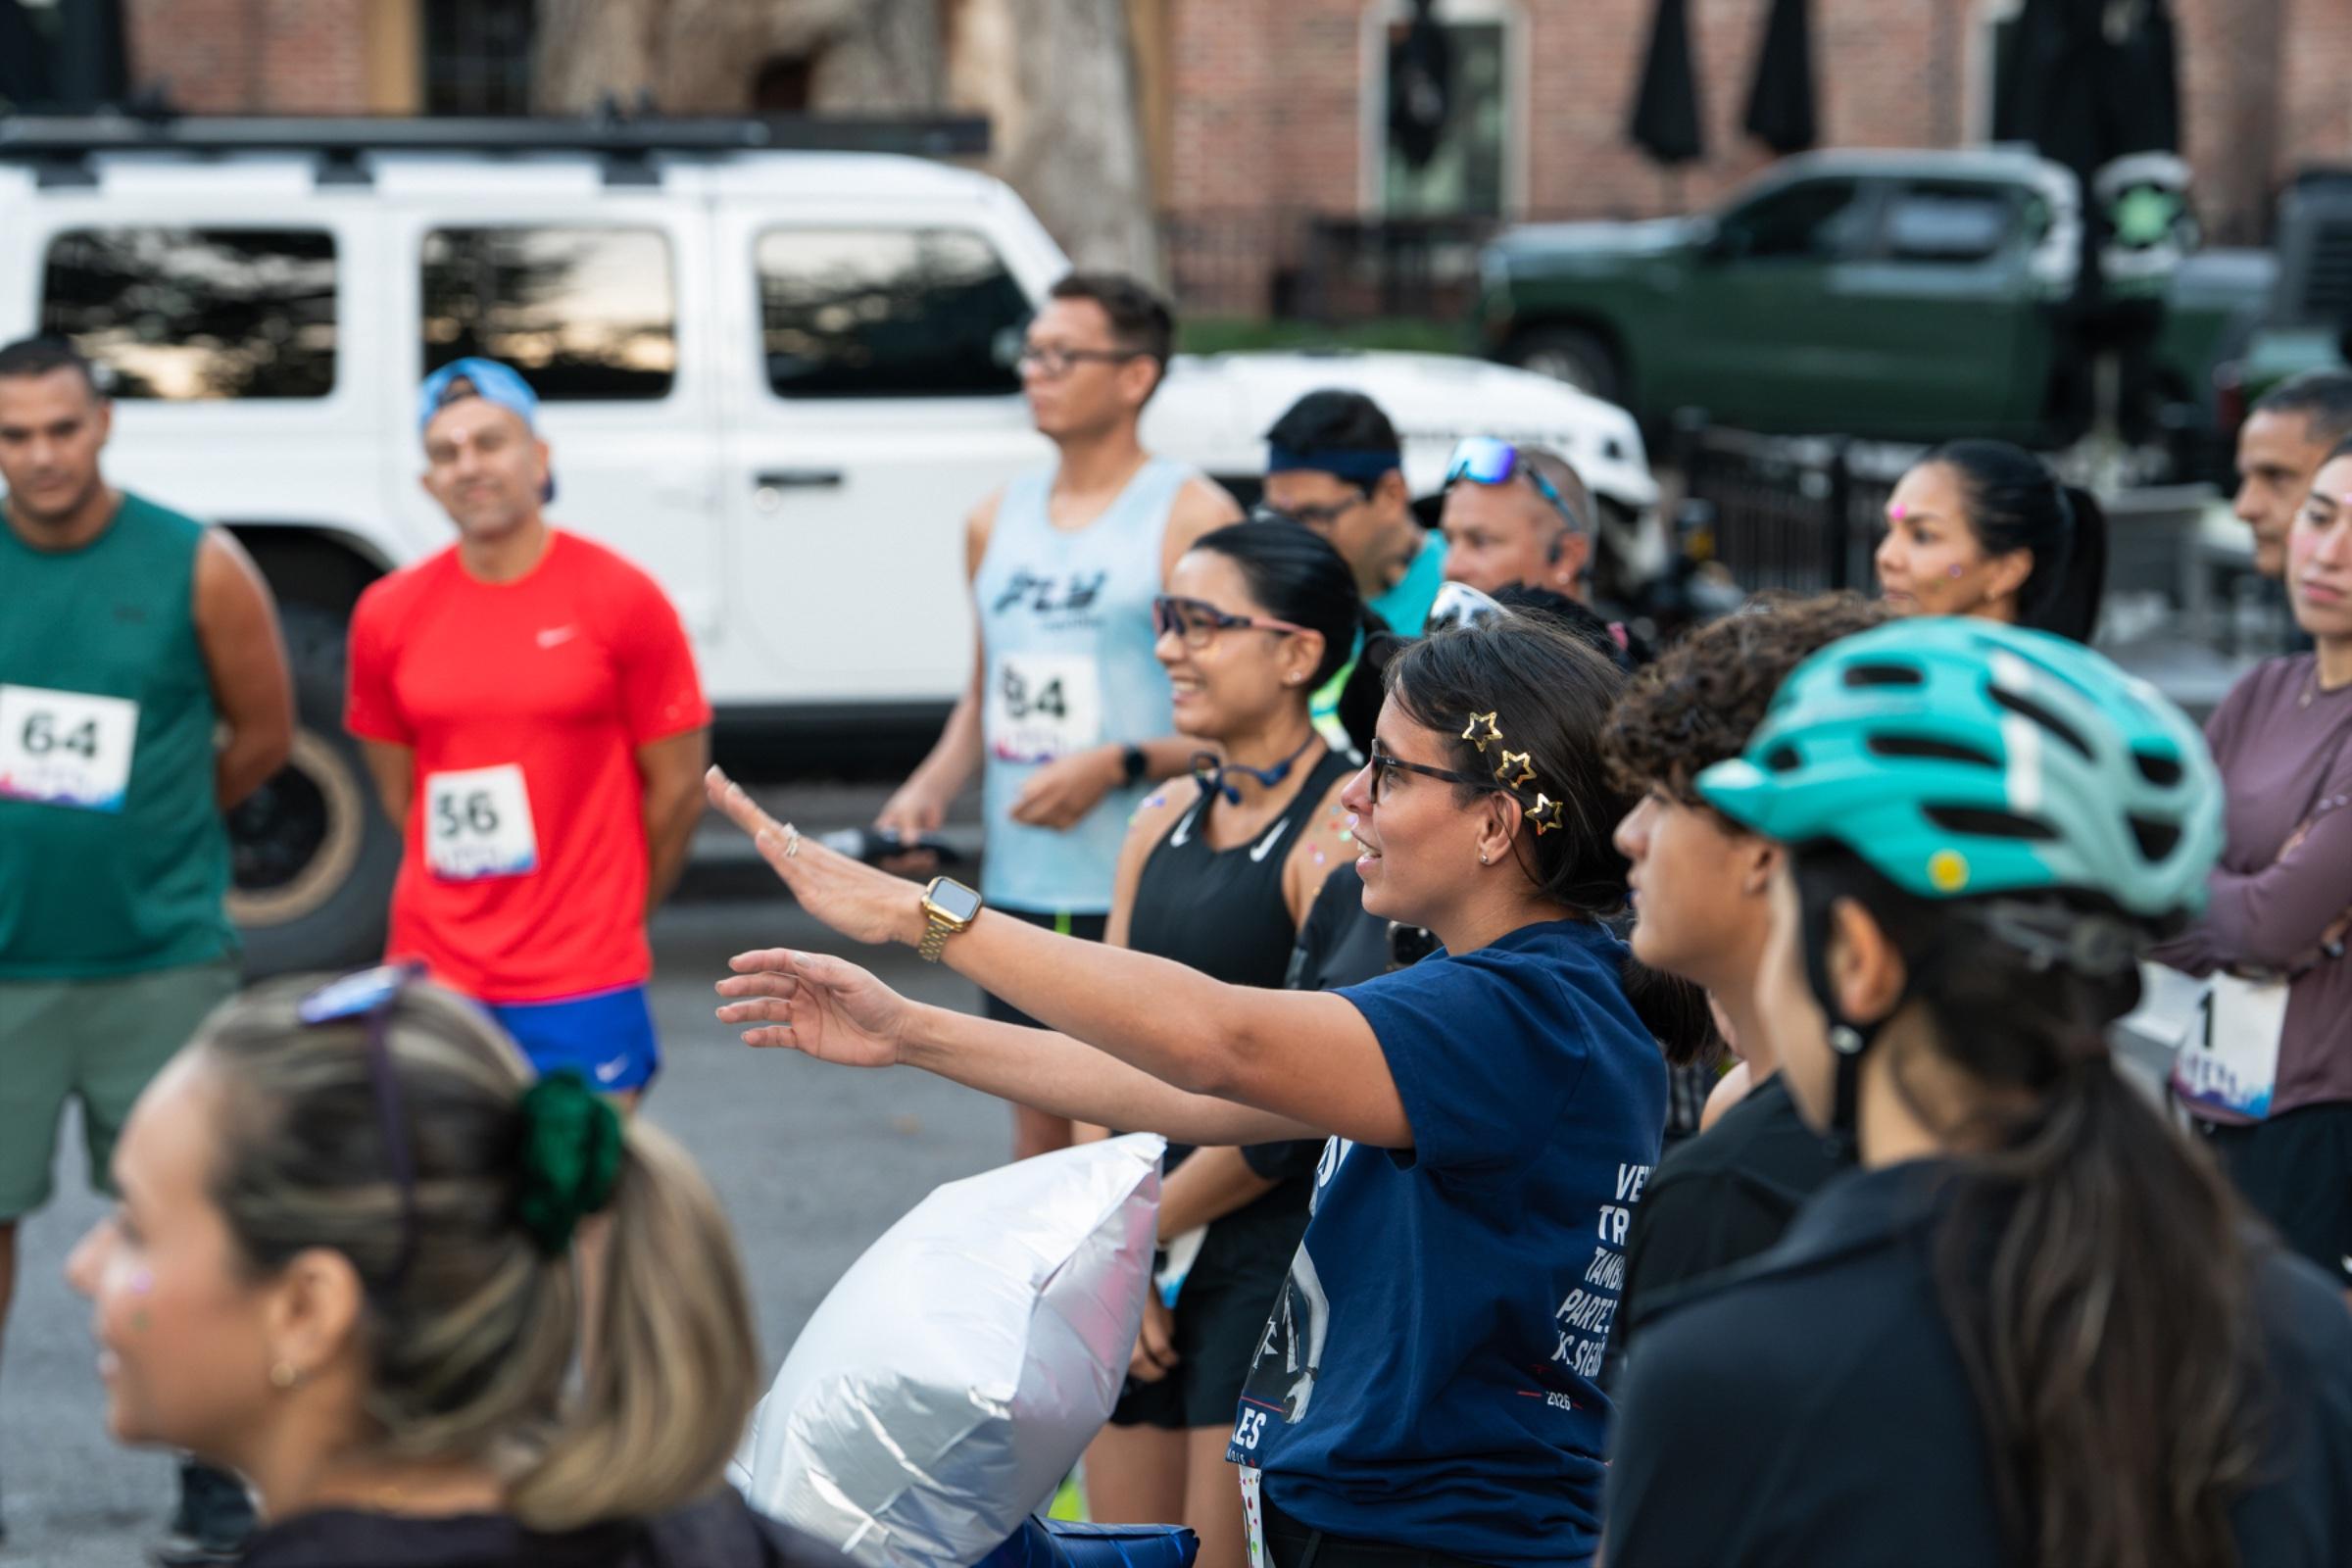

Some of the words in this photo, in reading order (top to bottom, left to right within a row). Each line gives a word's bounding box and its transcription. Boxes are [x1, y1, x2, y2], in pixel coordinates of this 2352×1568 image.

[22, 710, 97, 760] 64
[1585, 1246, 1627, 1291] TAMB
[1556, 1288, 1618, 1334] PARTE
[1232, 1406, 1267, 1450] ES
